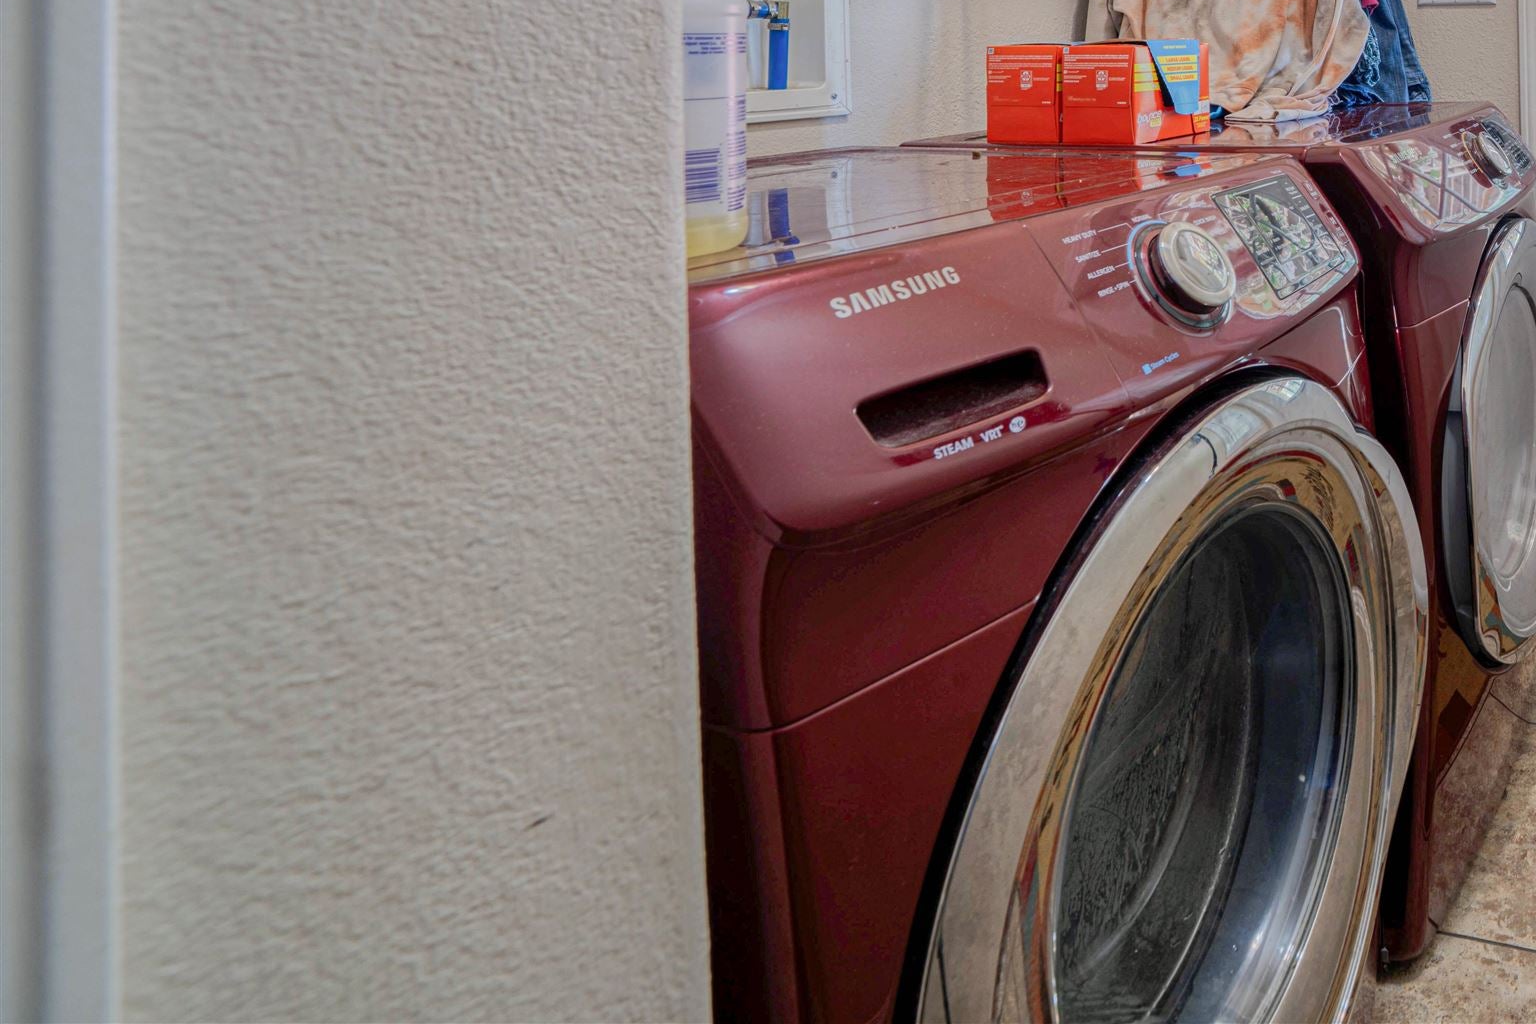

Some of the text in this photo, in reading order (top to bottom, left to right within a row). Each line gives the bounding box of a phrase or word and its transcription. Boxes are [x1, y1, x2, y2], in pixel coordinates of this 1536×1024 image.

[1087, 265, 1115, 279] ALLERGEN
[830, 266, 961, 319] SAMSUNG
[934, 437, 974, 460] STEAM
